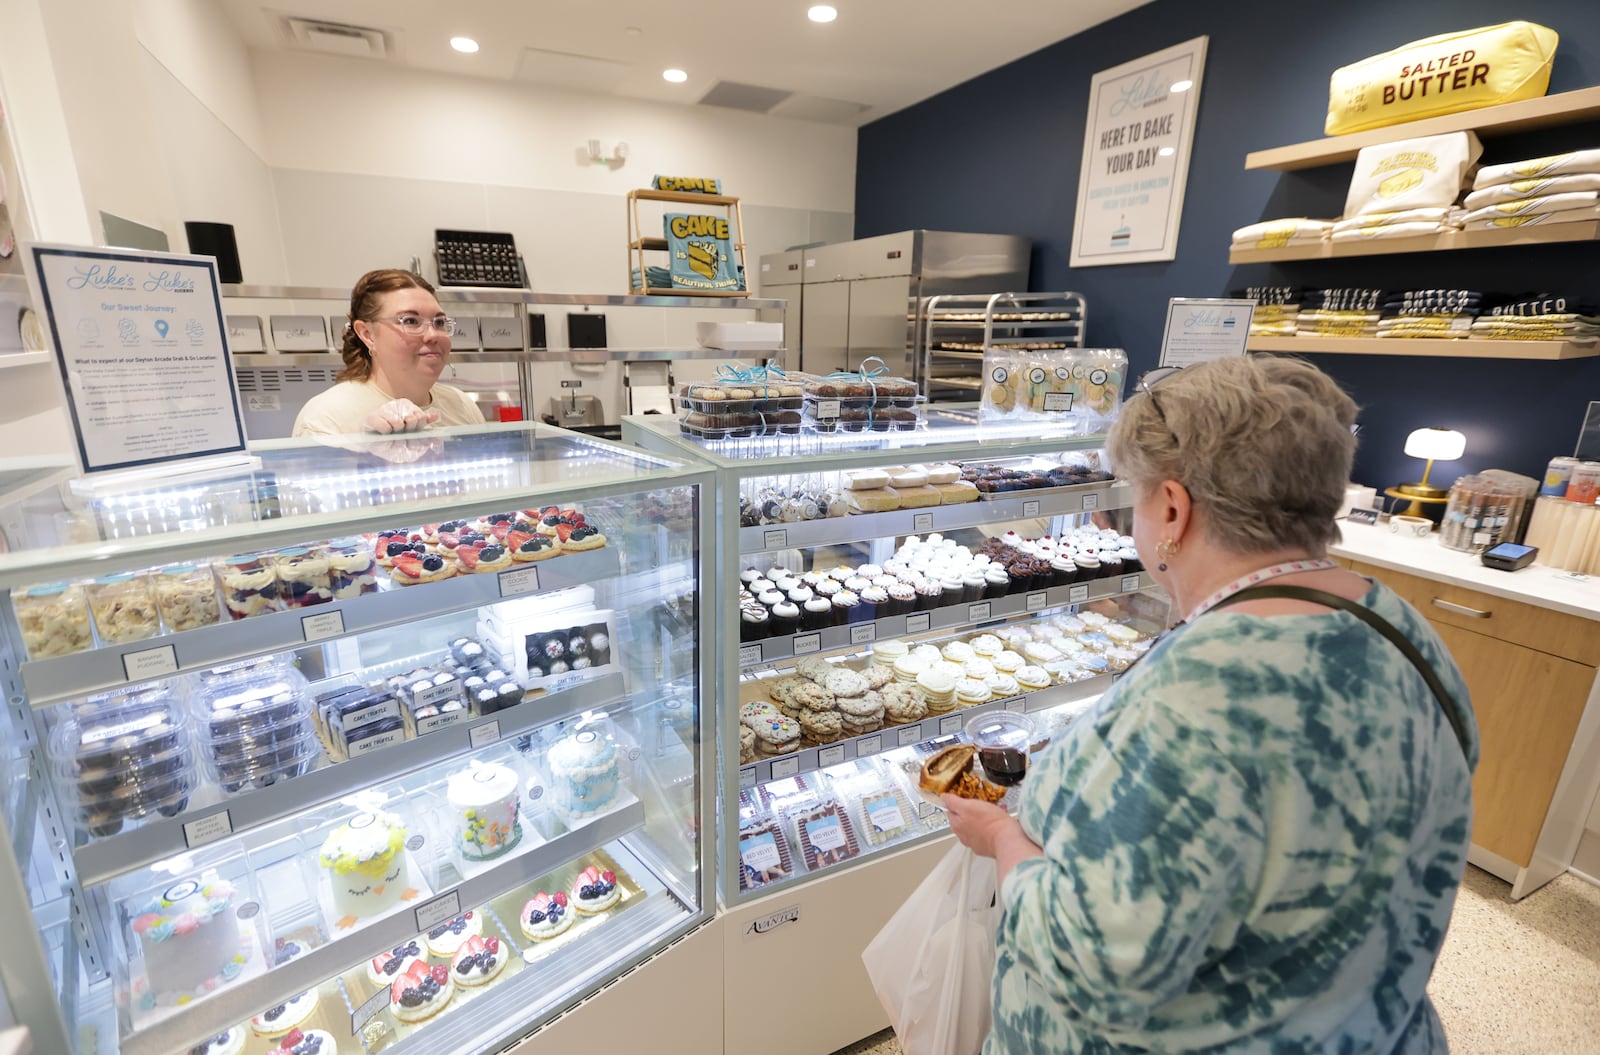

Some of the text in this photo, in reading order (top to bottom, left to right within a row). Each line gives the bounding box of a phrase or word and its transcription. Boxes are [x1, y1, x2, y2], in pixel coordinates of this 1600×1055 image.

[1400, 50, 1476, 78] SALTED
[1383, 63, 1490, 105] BUTTER
[1100, 113, 1174, 150] HERE TO BAKE
[1107, 145, 1159, 175] YOUR DAY
[657, 176, 718, 194] CAKE
[671, 215, 730, 240] CAKE
[67, 265, 196, 292] Luke's Luke's
[673, 275, 737, 289] BEAUTIFUL THING
[368, 707, 387, 718] TRUFFLE
[440, 714, 459, 724] TRUFFLE
[359, 736, 394, 750] CAKE TRUFFLE
[823, 828, 838, 838] VELVET
[756, 846, 773, 857] VELVET
